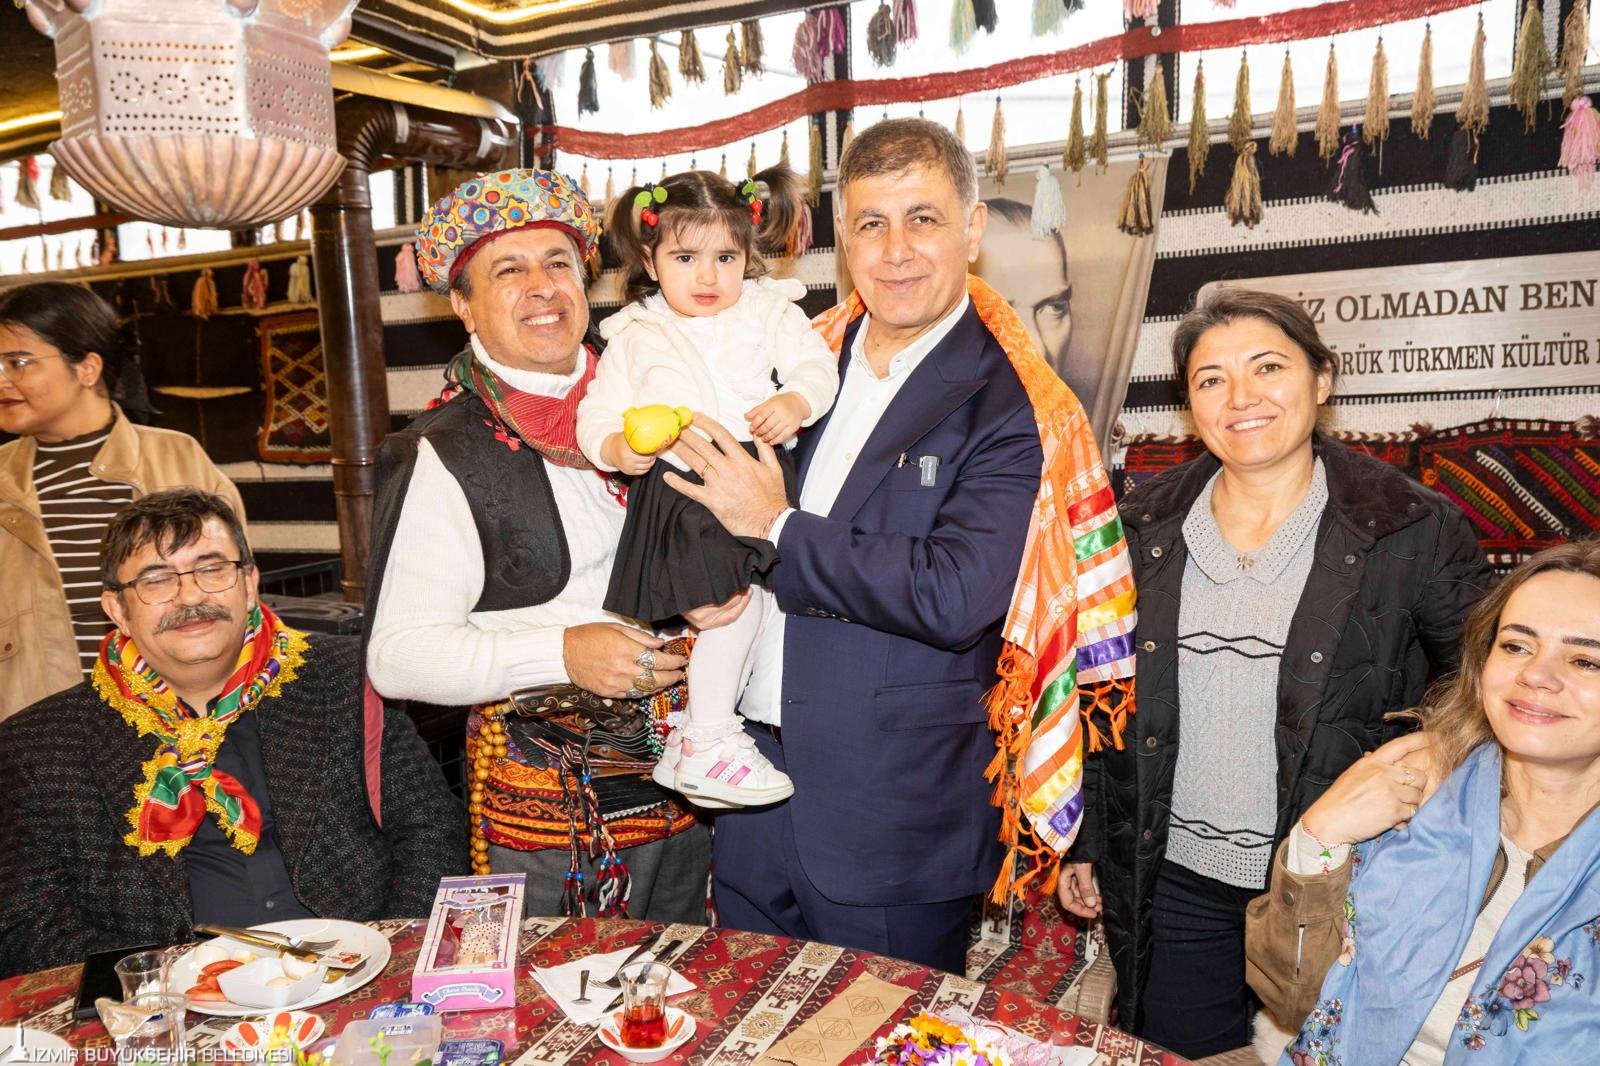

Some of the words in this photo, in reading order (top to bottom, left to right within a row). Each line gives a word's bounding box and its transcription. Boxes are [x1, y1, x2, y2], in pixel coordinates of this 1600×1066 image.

[1336, 284, 1509, 322] OLMADAN
[1520, 279, 1598, 311] BEN
[1388, 341, 1496, 373] TÜRKMEN
[1501, 332, 1590, 368] KÜLTÜR
